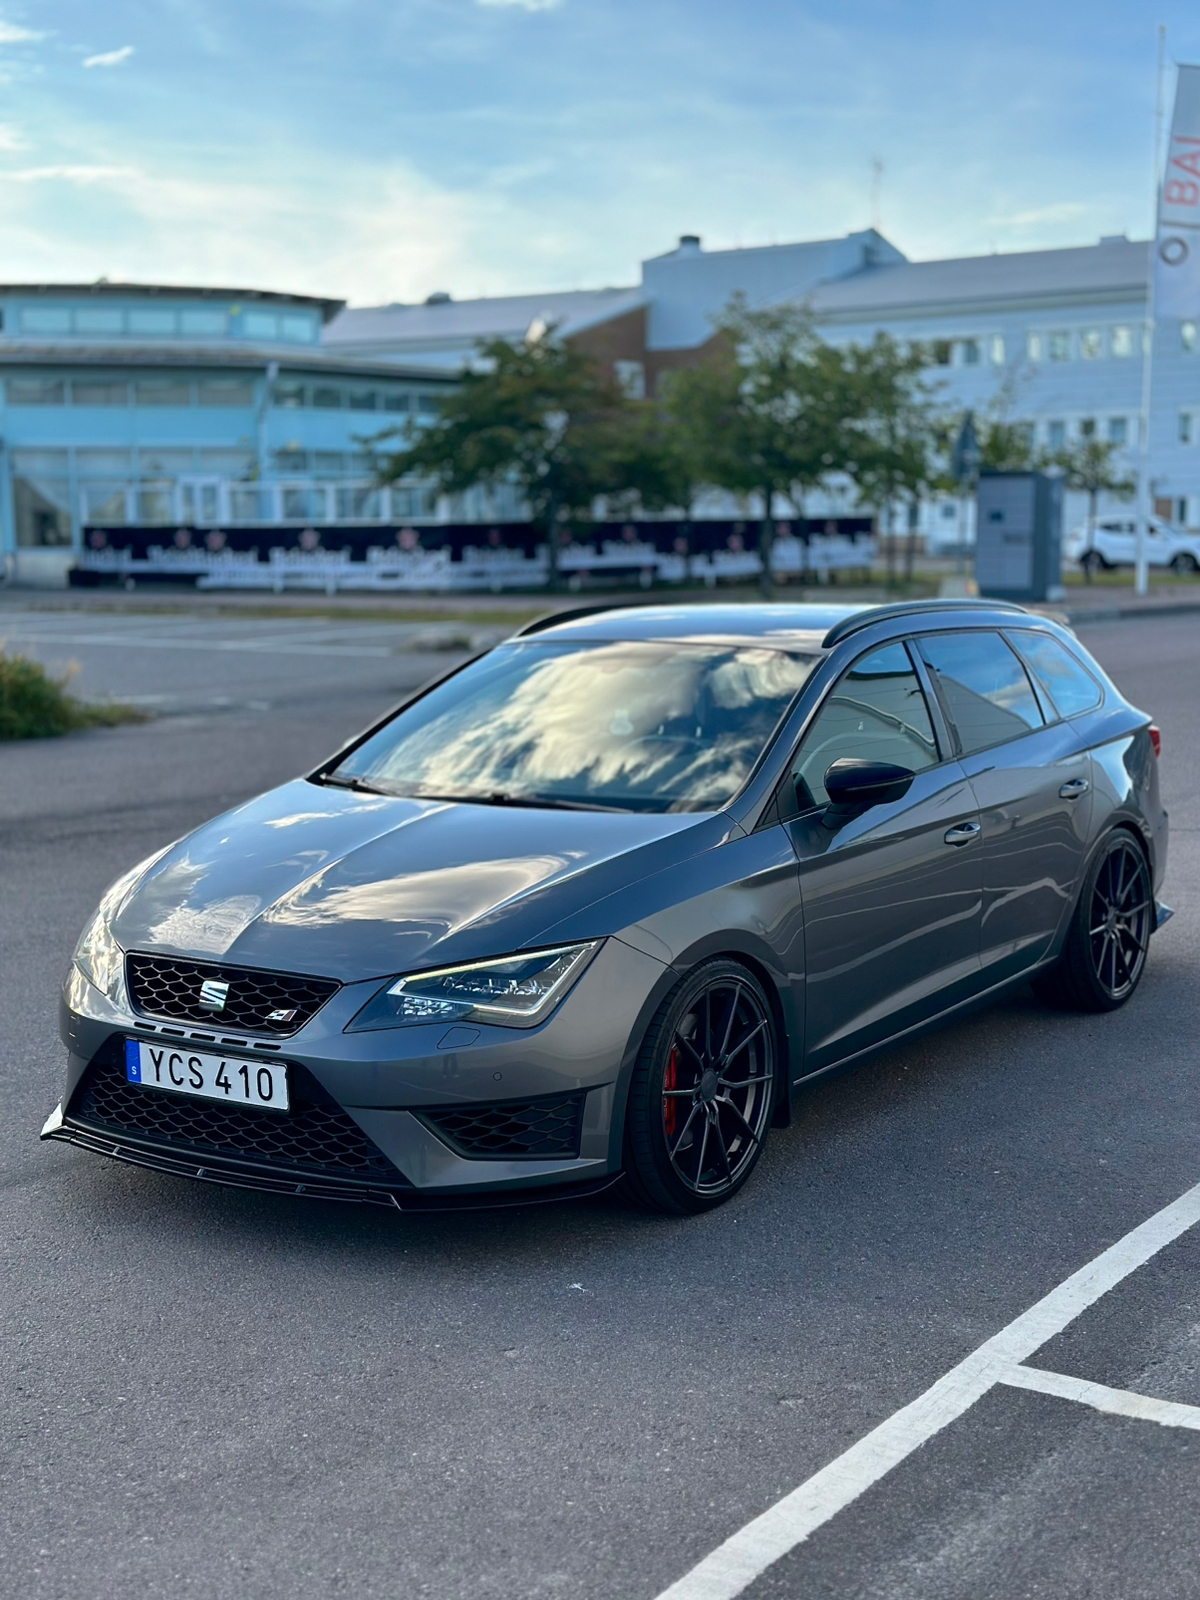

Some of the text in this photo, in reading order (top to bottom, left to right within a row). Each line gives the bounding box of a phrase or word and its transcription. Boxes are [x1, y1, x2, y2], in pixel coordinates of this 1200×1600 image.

[131, 1066, 138, 1075] S
[149, 1048, 273, 1101] YCS 410
